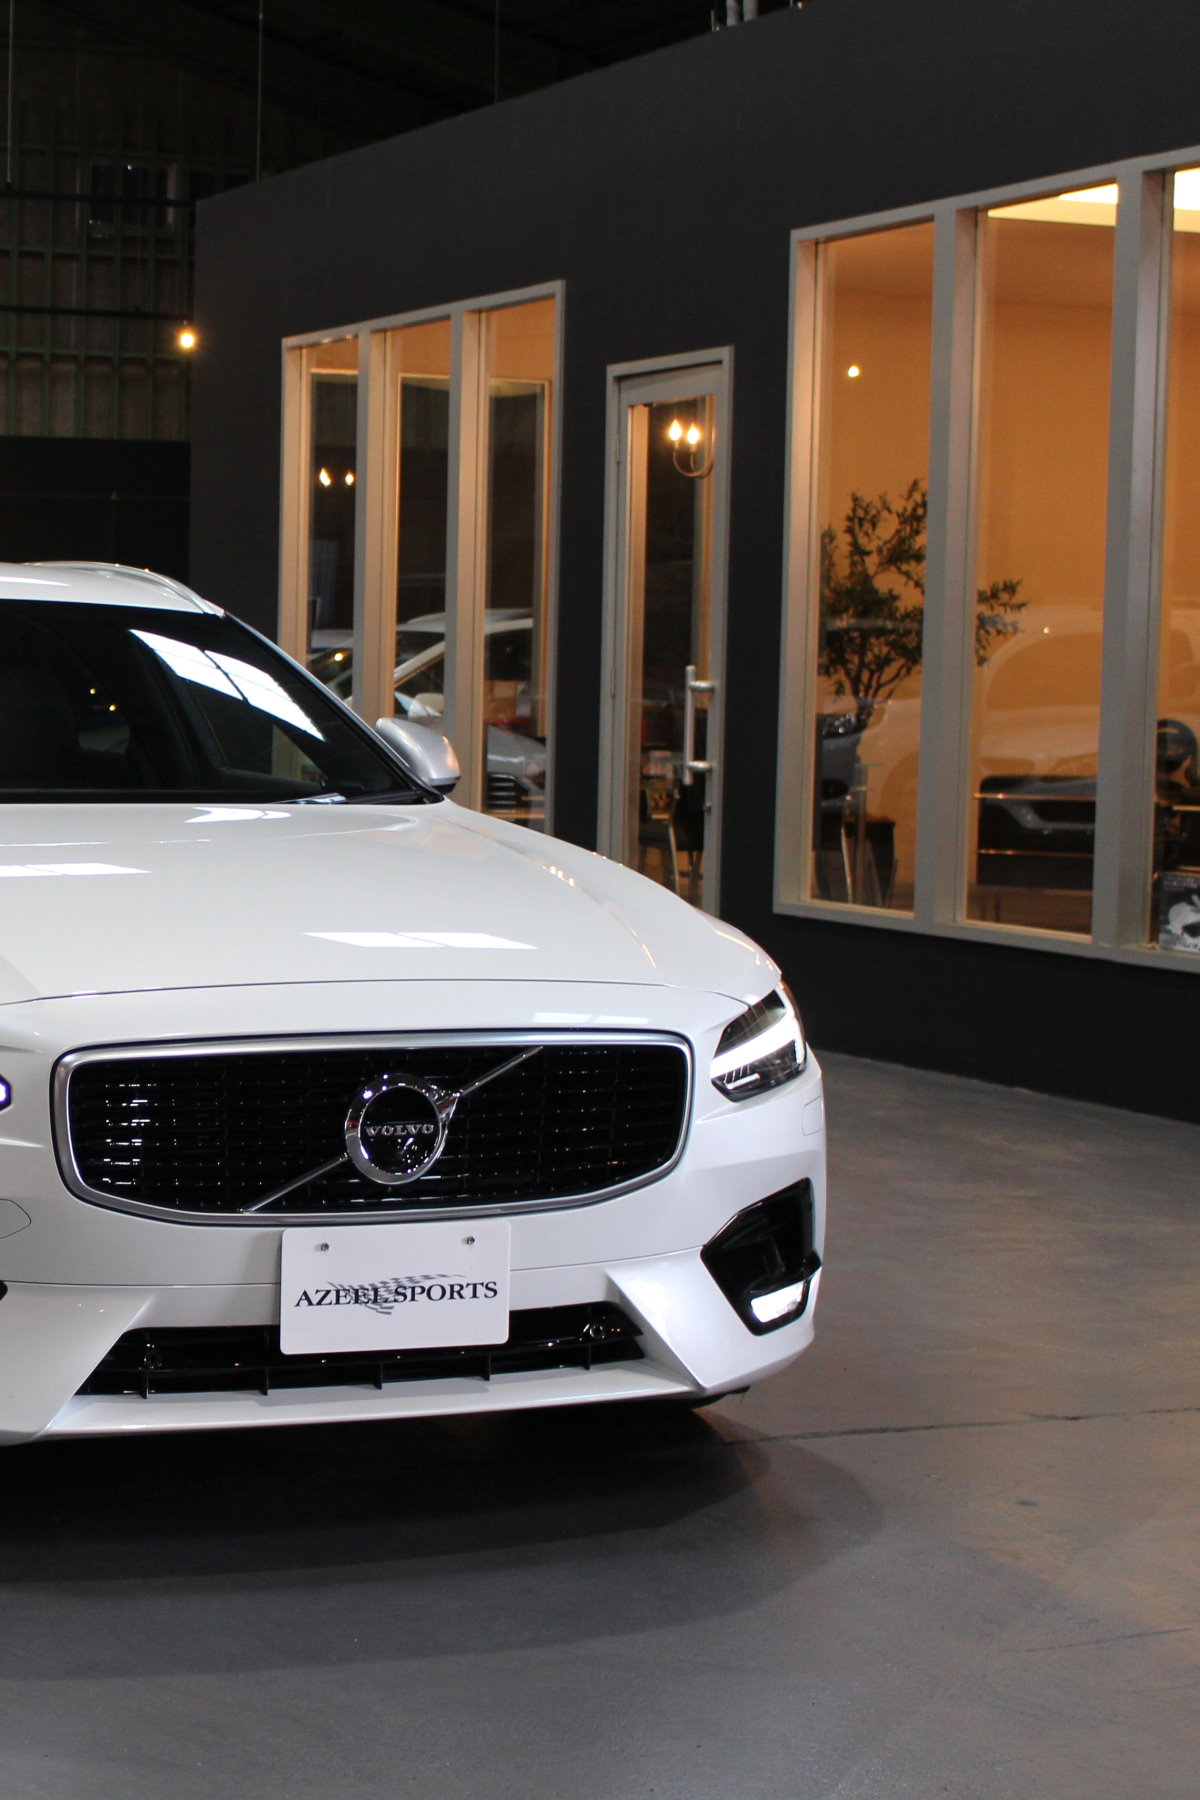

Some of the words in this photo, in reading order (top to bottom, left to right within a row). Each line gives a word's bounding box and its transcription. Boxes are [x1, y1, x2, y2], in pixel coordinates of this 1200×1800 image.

[364, 1124, 434, 1136] VOLVO
[294, 1288, 389, 1307] AZEEL
[394, 1281, 498, 1303] SPORTS
